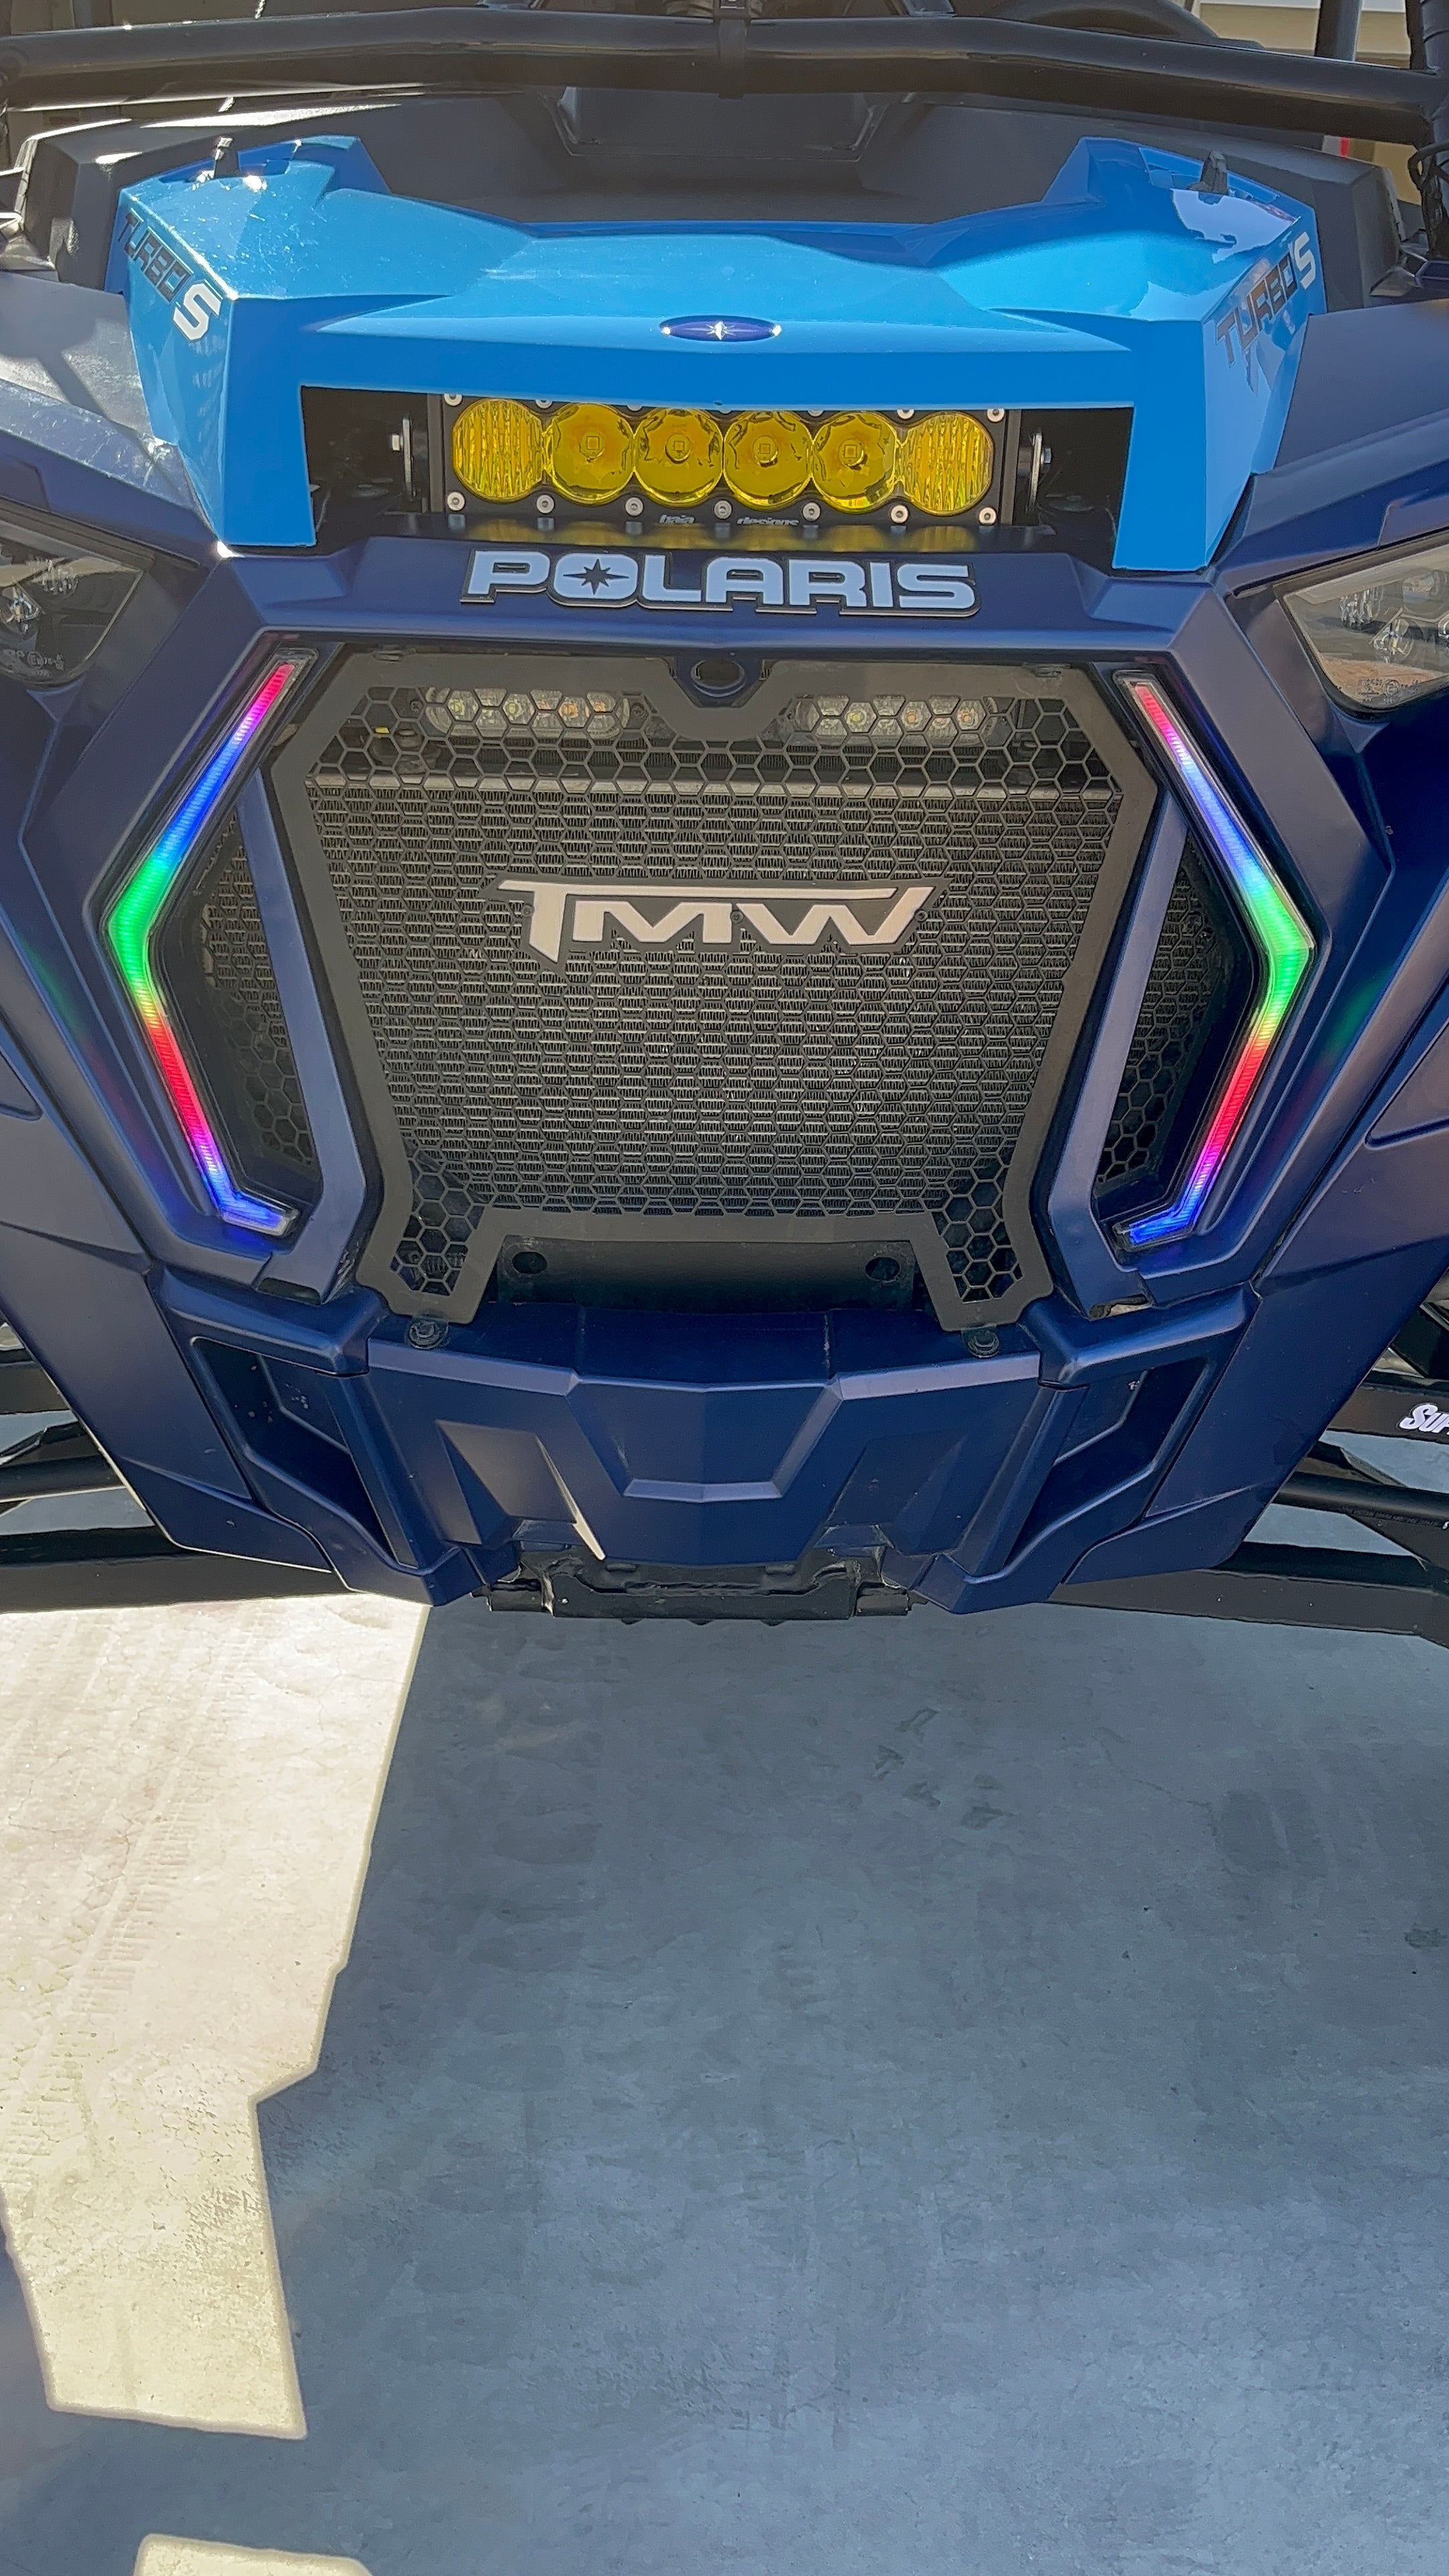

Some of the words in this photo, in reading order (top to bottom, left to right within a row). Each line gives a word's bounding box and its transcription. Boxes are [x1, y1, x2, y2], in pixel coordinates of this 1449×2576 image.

[118, 209, 195, 304] TURBO
[172, 280, 223, 341] S
[1216, 252, 1297, 368] TURBO
[1293, 231, 1316, 290] S
[464, 550, 978, 613] POLARIS
[498, 879, 936, 964] TMW
